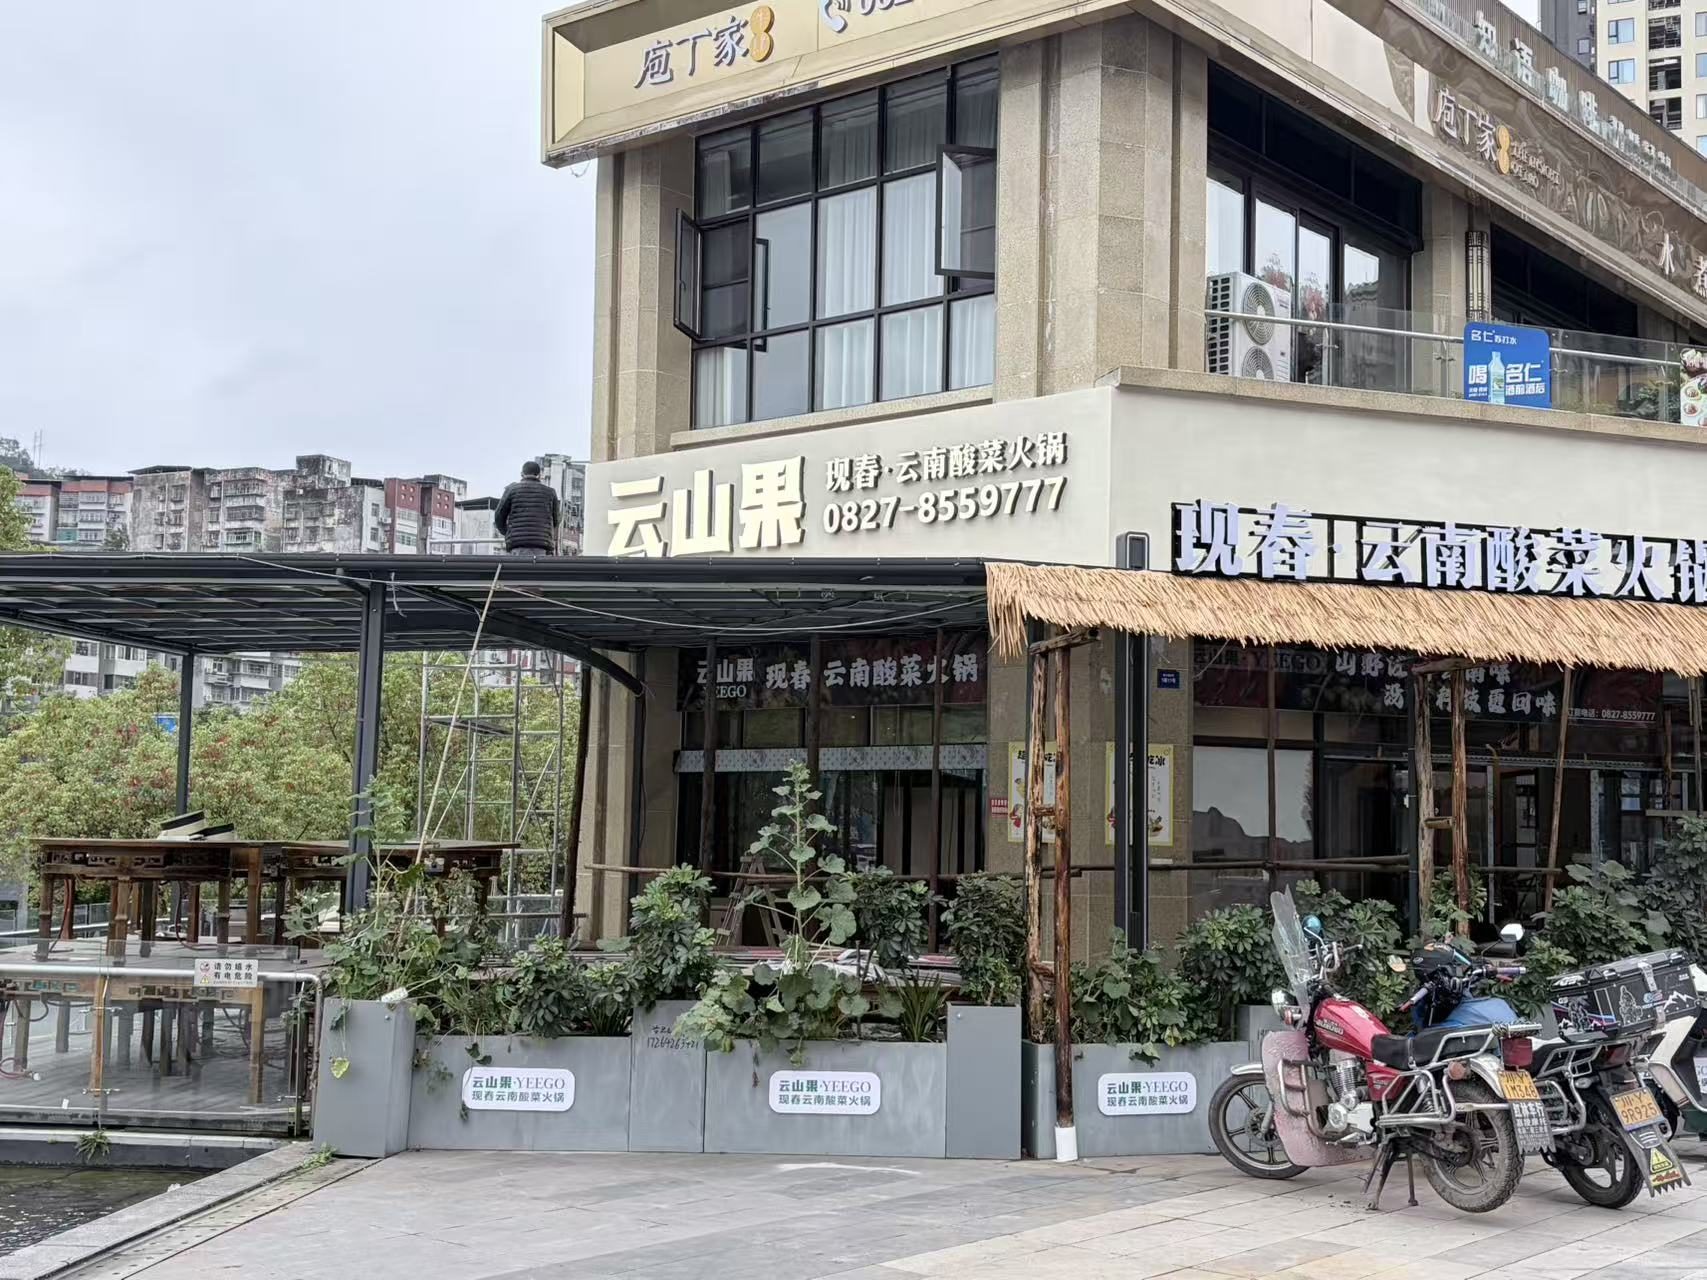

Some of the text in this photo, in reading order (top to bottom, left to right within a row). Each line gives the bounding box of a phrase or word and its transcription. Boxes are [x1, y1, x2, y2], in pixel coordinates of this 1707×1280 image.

[634, 16, 749, 89] 庖丁家
[1432, 87, 1497, 161] 庖丁家
[1468, 362, 1542, 385] 喝 名仁
[607, 456, 806, 557] 云山果
[823, 475, 1067, 533] 0827-8559777
[1621, 1102, 1658, 1123] 9R925
